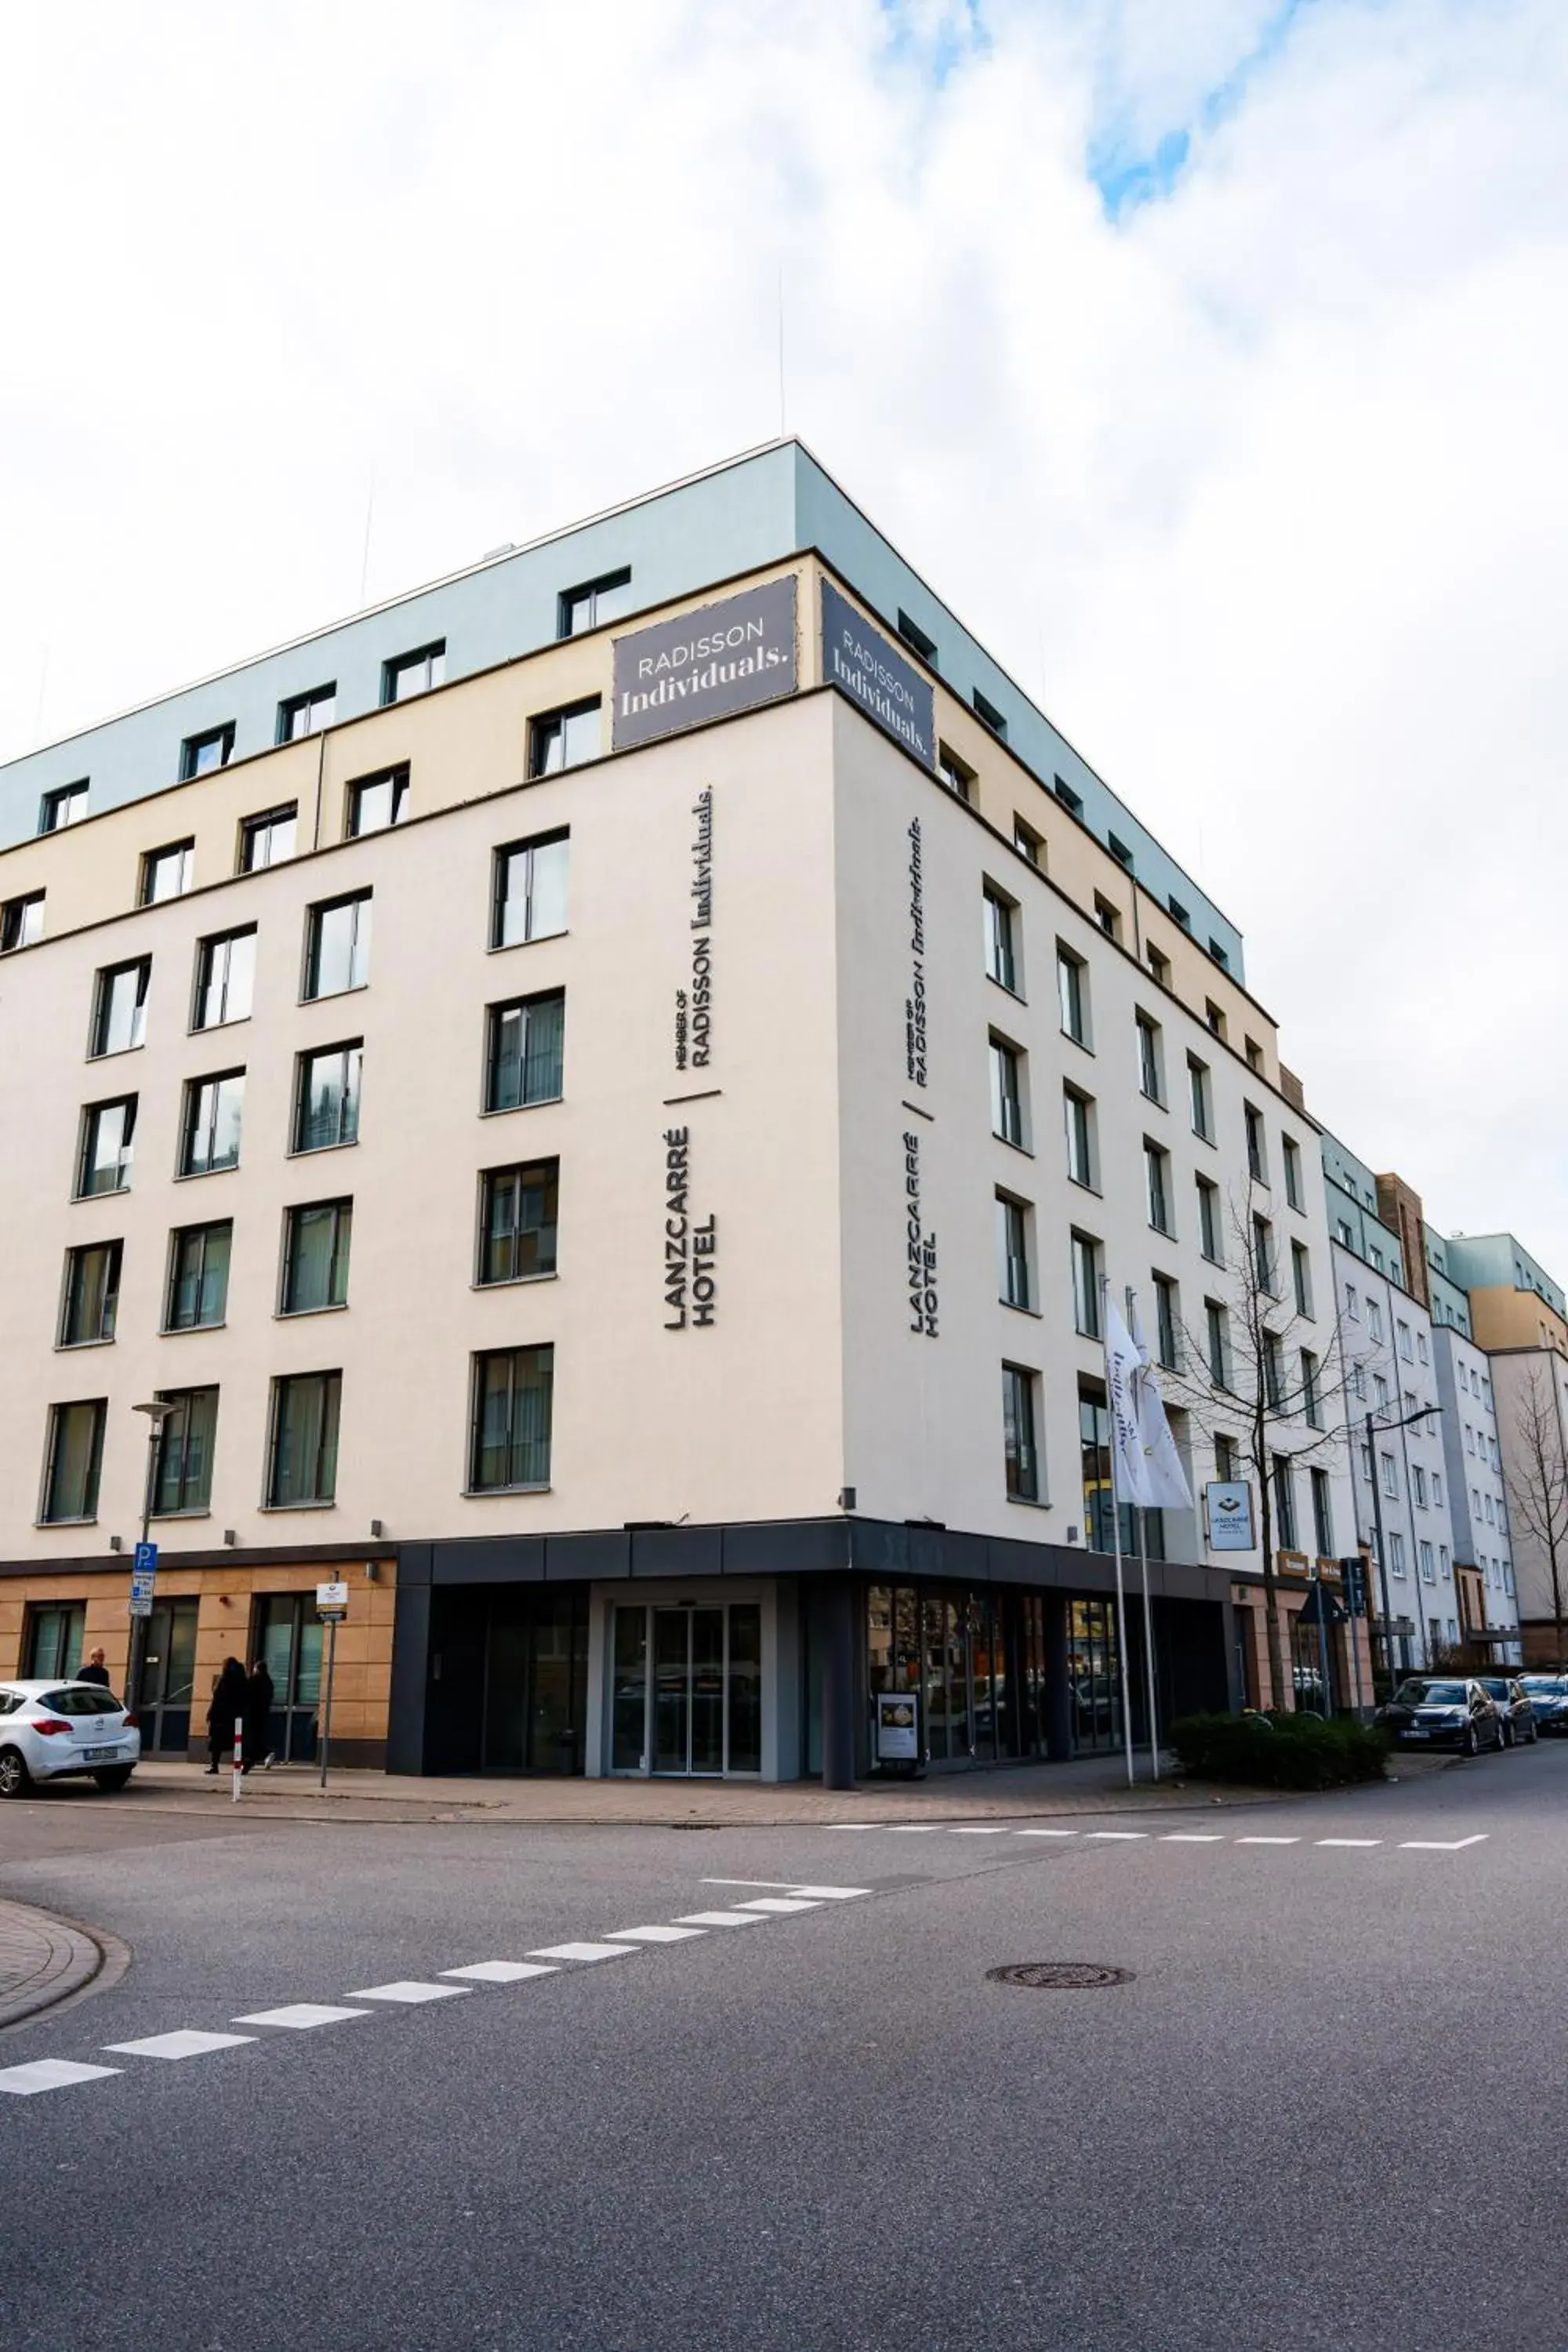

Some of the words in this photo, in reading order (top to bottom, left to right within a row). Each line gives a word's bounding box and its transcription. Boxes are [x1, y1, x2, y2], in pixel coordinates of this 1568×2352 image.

[621, 645, 788, 717] Individuals.
[639, 618, 764, 679] RADISSON
[833, 646, 928, 756] Individuals.
[843, 628, 914, 715] RADISSON
[691, 784, 713, 931] Individuals.
[676, 1011, 688, 1071] MEMBER
[677, 989, 688, 1010] OF
[692, 937, 711, 1069] RADISSON
[913, 960, 927, 1089] RADISSON
[662, 1126, 689, 1331] LANZCARRÉ
[693, 1213, 715, 1327] HOTEL
[902, 1131, 925, 1334] LANZCARRÉ
[924, 1232, 939, 1339] HOTEL
